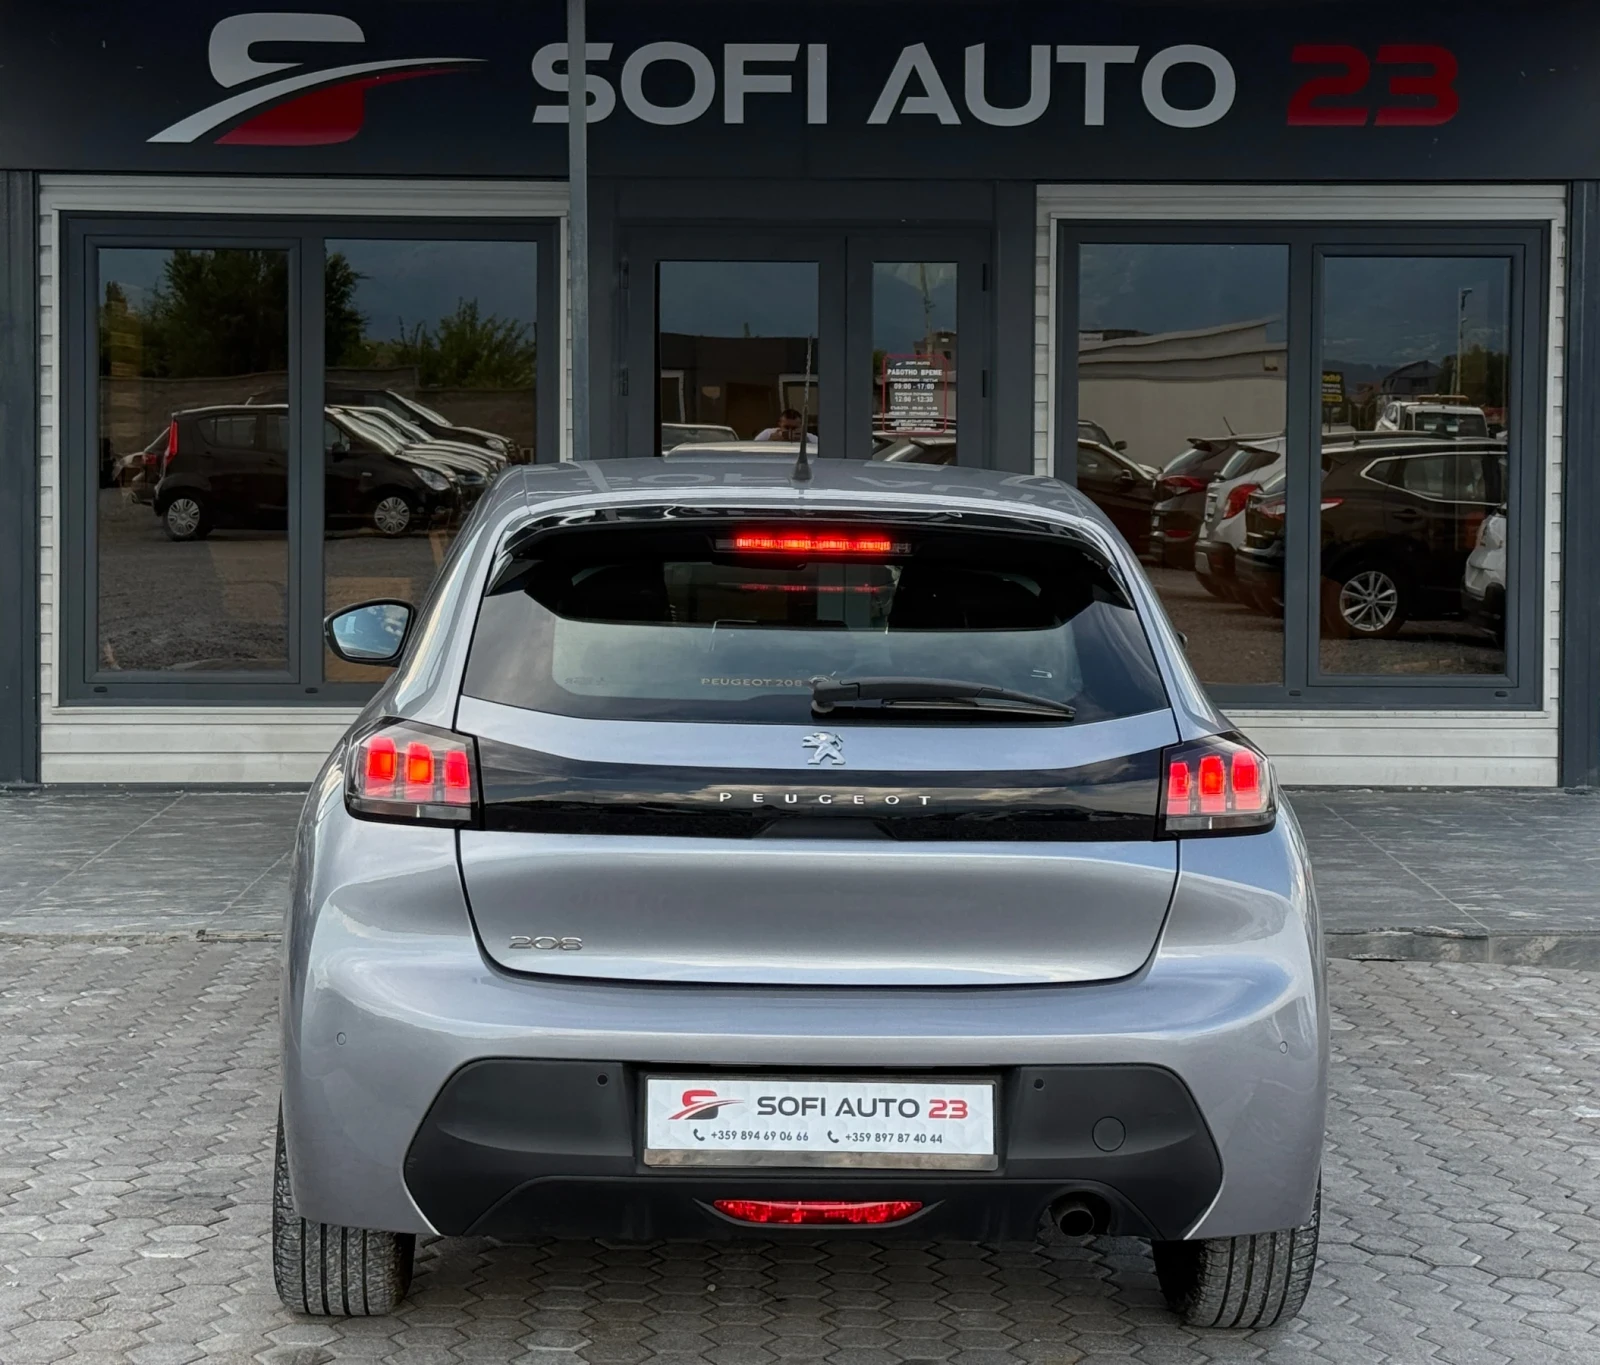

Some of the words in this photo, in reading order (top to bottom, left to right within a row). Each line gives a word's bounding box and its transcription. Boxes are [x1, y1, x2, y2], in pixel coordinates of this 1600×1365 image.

[531, 41, 828, 126] SOFI
[866, 42, 1237, 128] AUTO
[1286, 44, 1460, 126] 23
[701, 678, 772, 687] PEUGEOT
[775, 679, 802, 687] 208
[719, 792, 932, 806] PEUGEOT
[508, 935, 583, 951] 208
[757, 1096, 826, 1117] SOFI
[834, 1097, 920, 1118] AUTO
[928, 1099, 969, 1119] 23
[711, 1130, 737, 1140] +359
[740, 1130, 760, 1140] 894
[763, 1131, 777, 1140] 69
[779, 1131, 793, 1141] 06
[796, 1131, 809, 1141] 66
[845, 1132, 871, 1142] +359
[874, 1132, 894, 1142] 897
[897, 1133, 910, 1143] 87
[913, 1133, 927, 1143] 40
[929, 1133, 942, 1143] 44
